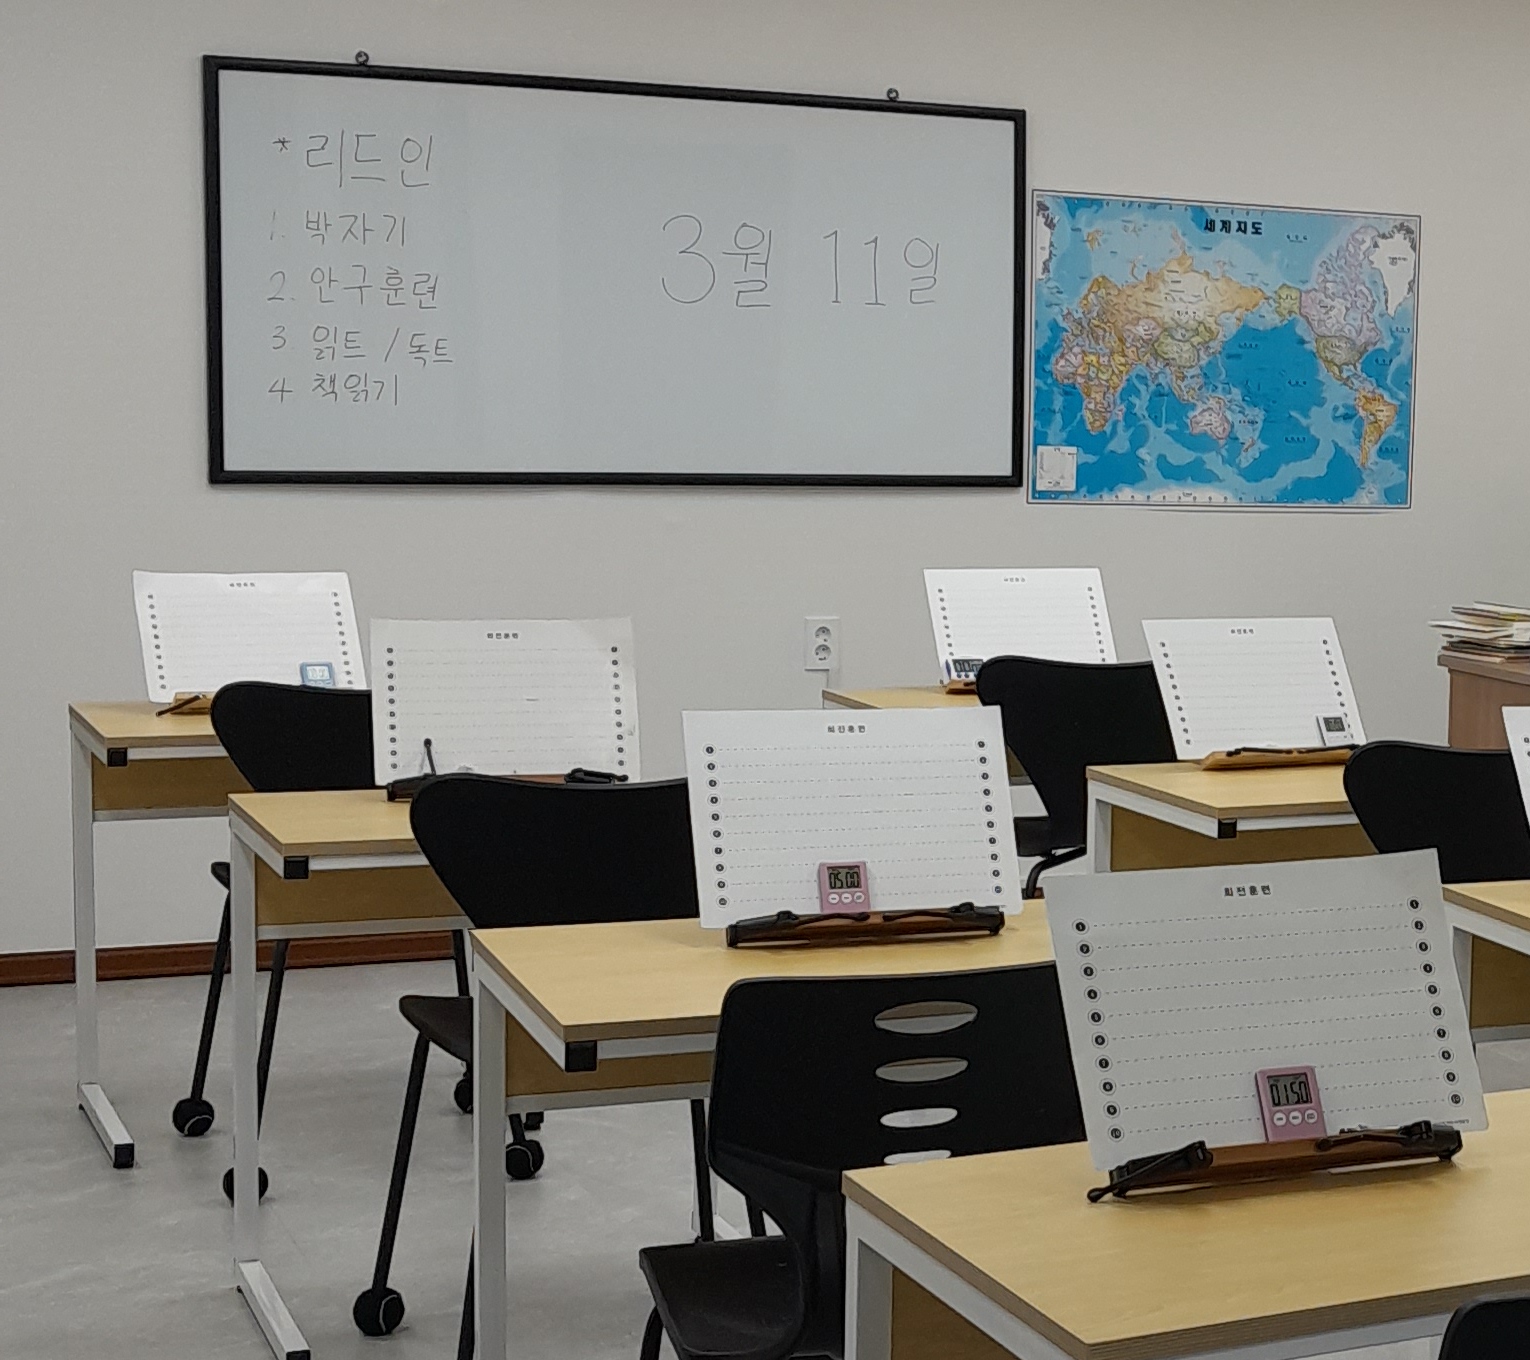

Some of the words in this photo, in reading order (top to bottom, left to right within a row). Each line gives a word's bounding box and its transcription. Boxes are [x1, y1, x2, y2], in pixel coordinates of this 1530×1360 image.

[306, 128, 433, 188] 리드인
[305, 210, 406, 247] 박자기
[1203, 218, 1263, 235] 세계지도
[661, 214, 772, 308] 3월
[822, 229, 940, 308] 11일
[310, 264, 440, 310] 안구훈련
[311, 372, 399, 406] 책읽기
